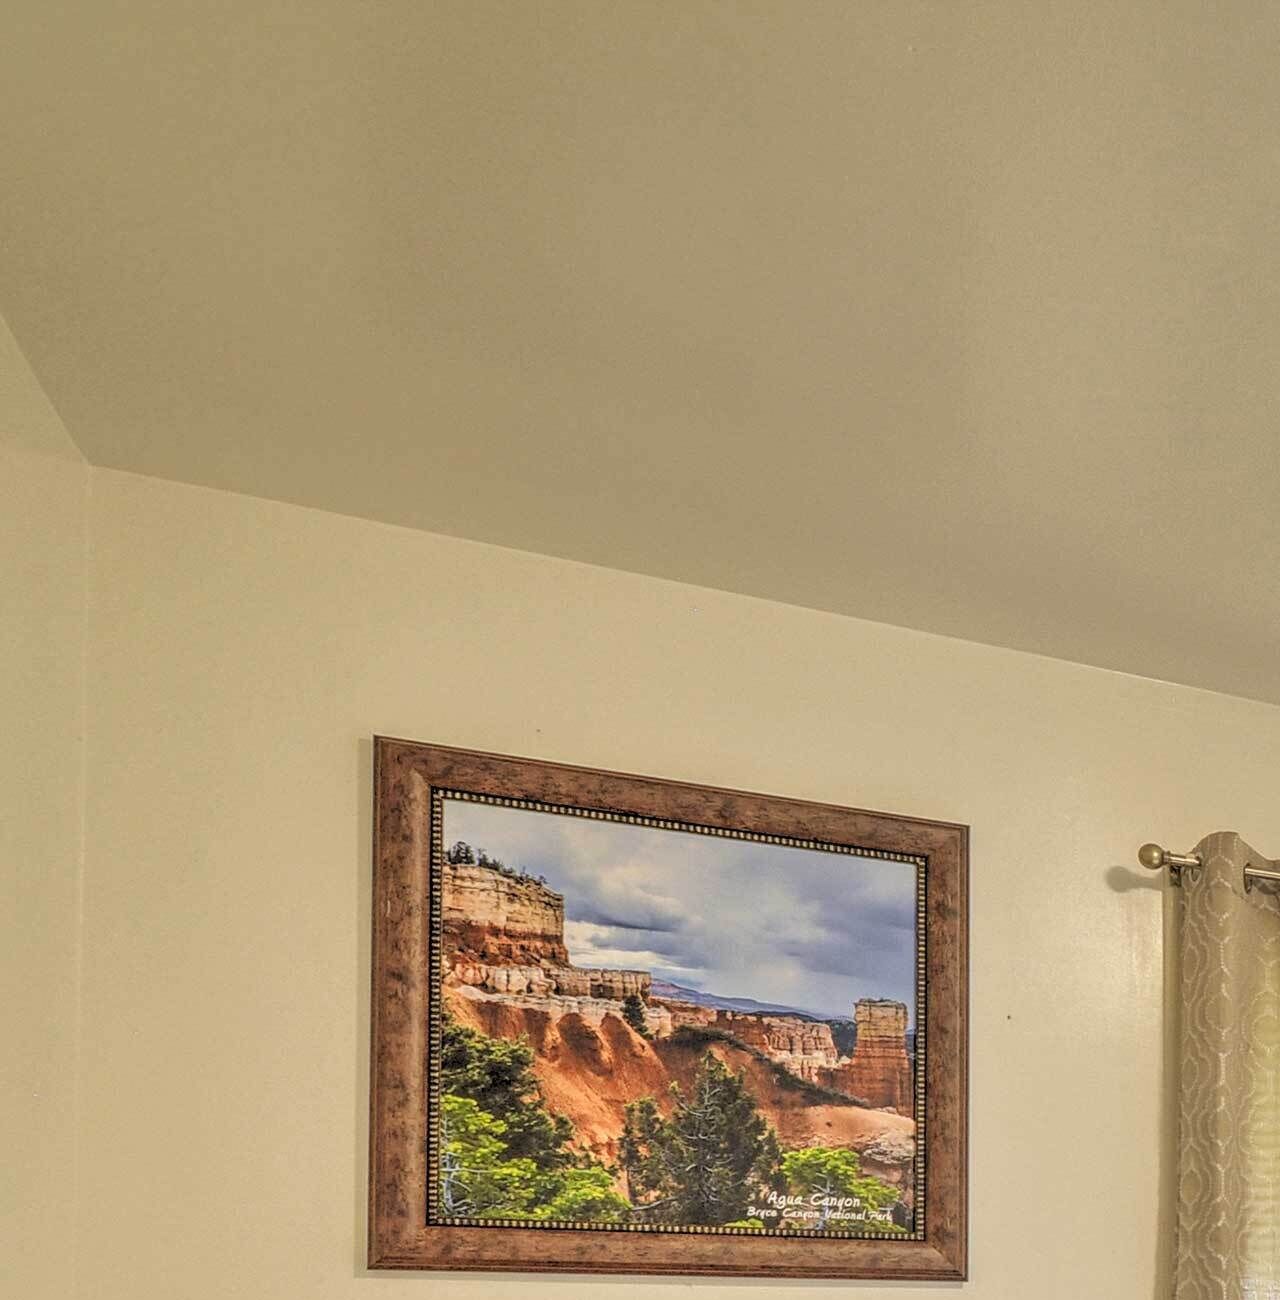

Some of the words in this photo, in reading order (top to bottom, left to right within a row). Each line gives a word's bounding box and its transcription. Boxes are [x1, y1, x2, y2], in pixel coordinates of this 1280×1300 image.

[767, 1191, 804, 1210] Agua
[810, 1193, 861, 1212] Canyon
[746, 1207, 778, 1221] Bryce
[782, 1208, 821, 1222] Canyon
[824, 1207, 866, 1221] National
[866, 1210, 893, 1223] Park
